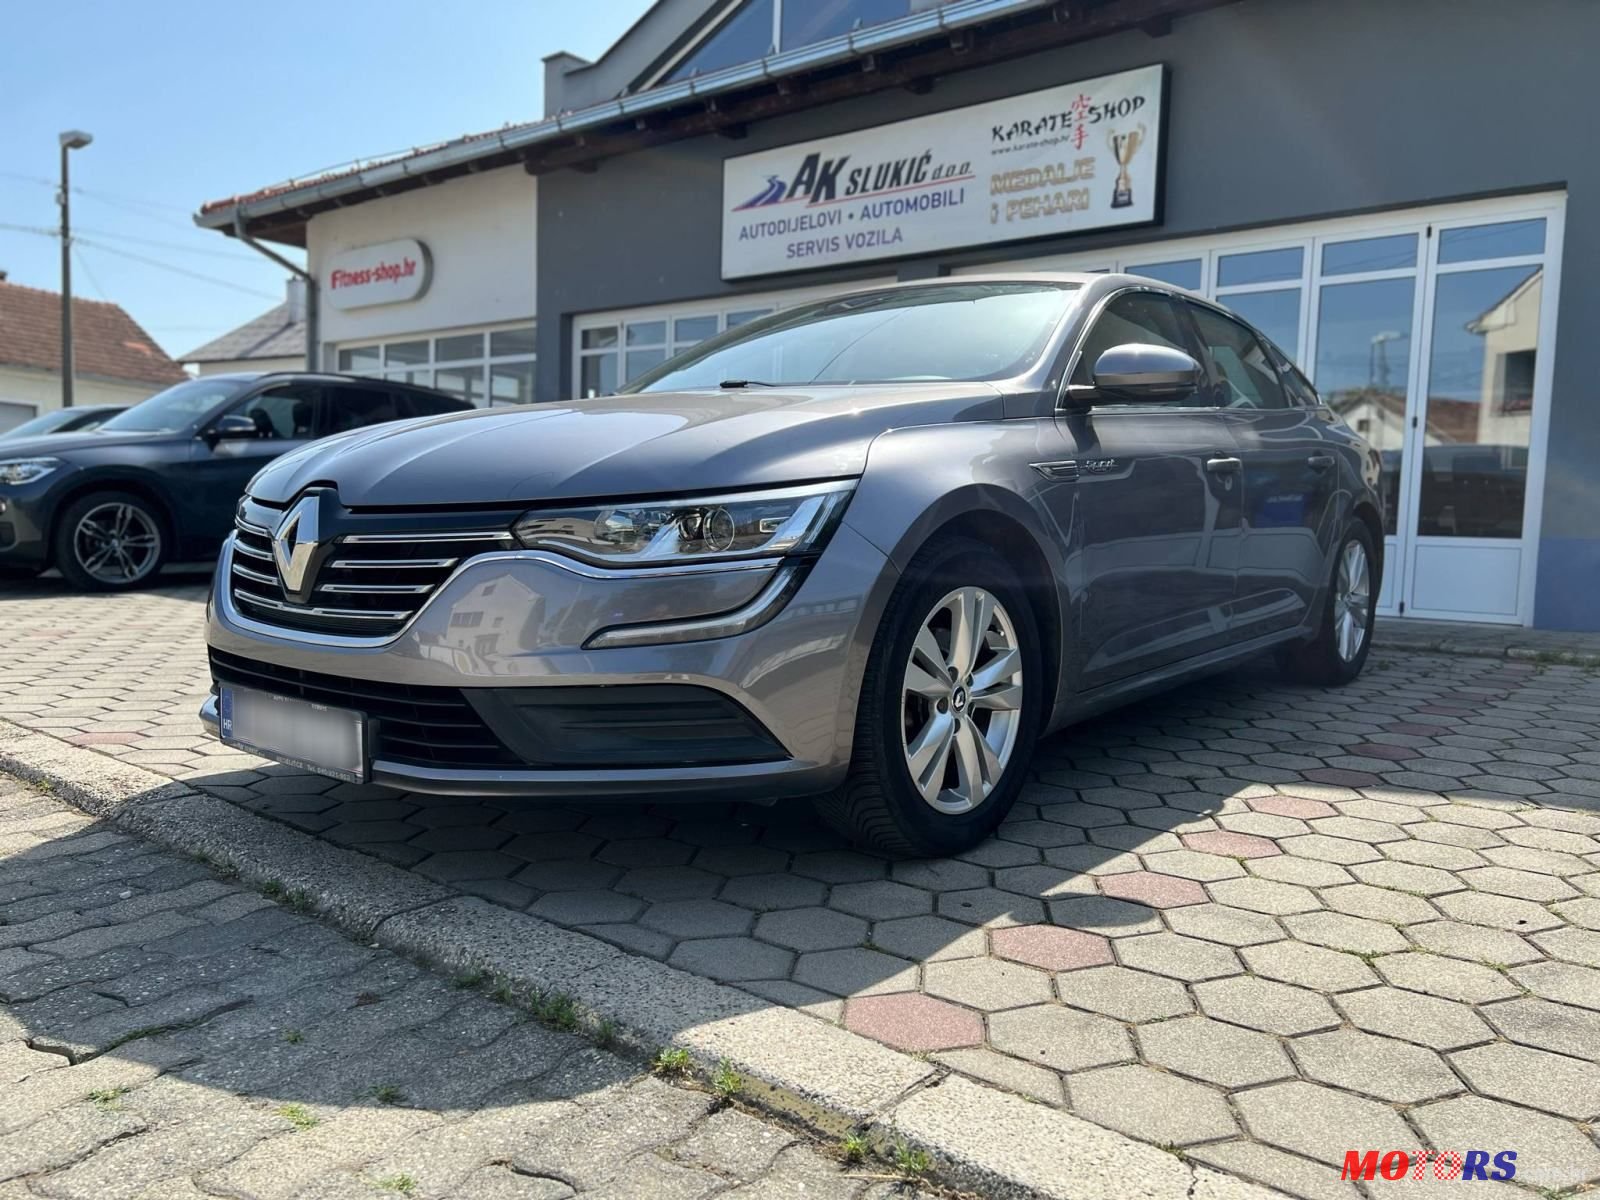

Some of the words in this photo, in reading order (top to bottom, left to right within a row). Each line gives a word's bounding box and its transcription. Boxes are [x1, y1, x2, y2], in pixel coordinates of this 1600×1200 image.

[991, 110, 1073, 143] KARATE
[1087, 95, 1145, 124] SHOP
[785, 152, 851, 204] AK
[844, 149, 932, 196] SLUKIĆ
[989, 156, 1096, 196] MEDALJE
[739, 209, 842, 241] AUTODIJELOVI
[860, 188, 965, 221] AUTOMOBILI
[1006, 188, 1090, 222] PEHARI
[786, 236, 840, 259] SERVIS
[845, 227, 904, 251] VOZILA
[331, 256, 417, 290] Fitness-shop.hr
[223, 718, 233, 731] HR
